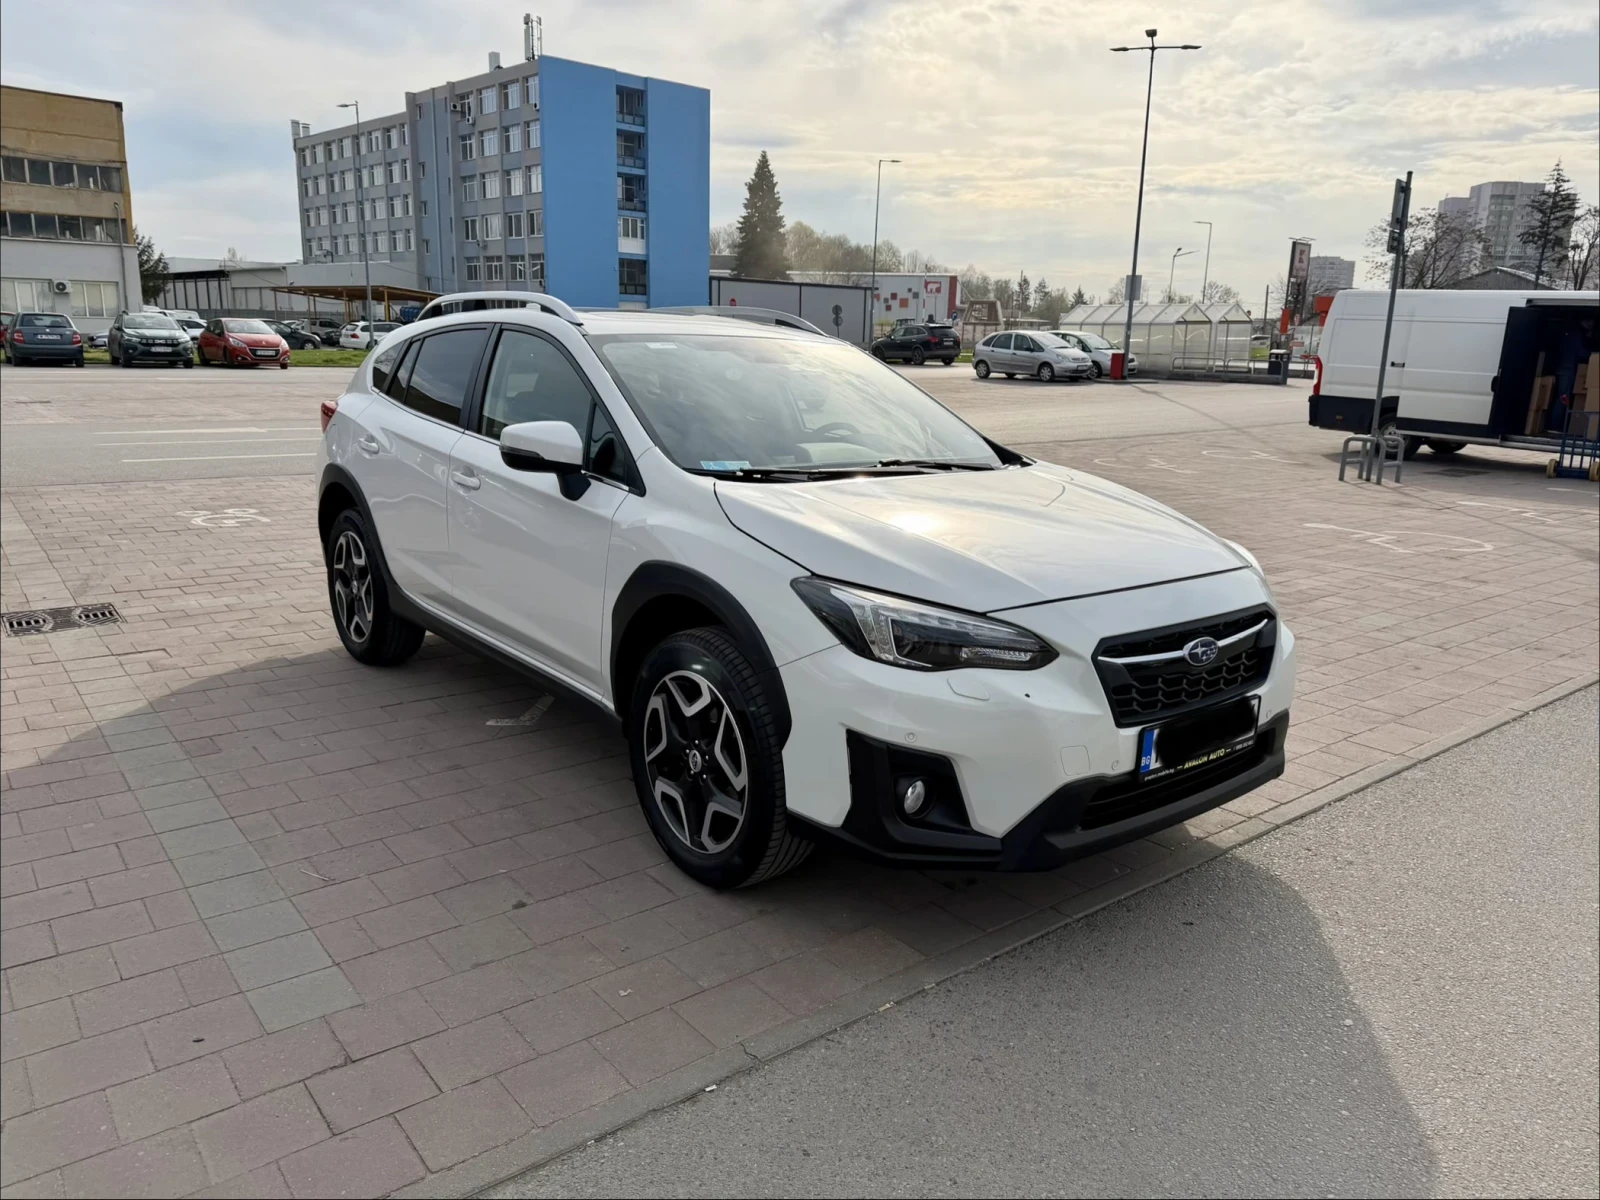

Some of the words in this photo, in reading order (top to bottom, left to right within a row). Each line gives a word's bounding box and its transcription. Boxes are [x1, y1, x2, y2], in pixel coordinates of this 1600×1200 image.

[1141, 755, 1151, 767] BG
[1184, 754, 1208, 769] AVALON
[1209, 748, 1225, 761] AUTO
